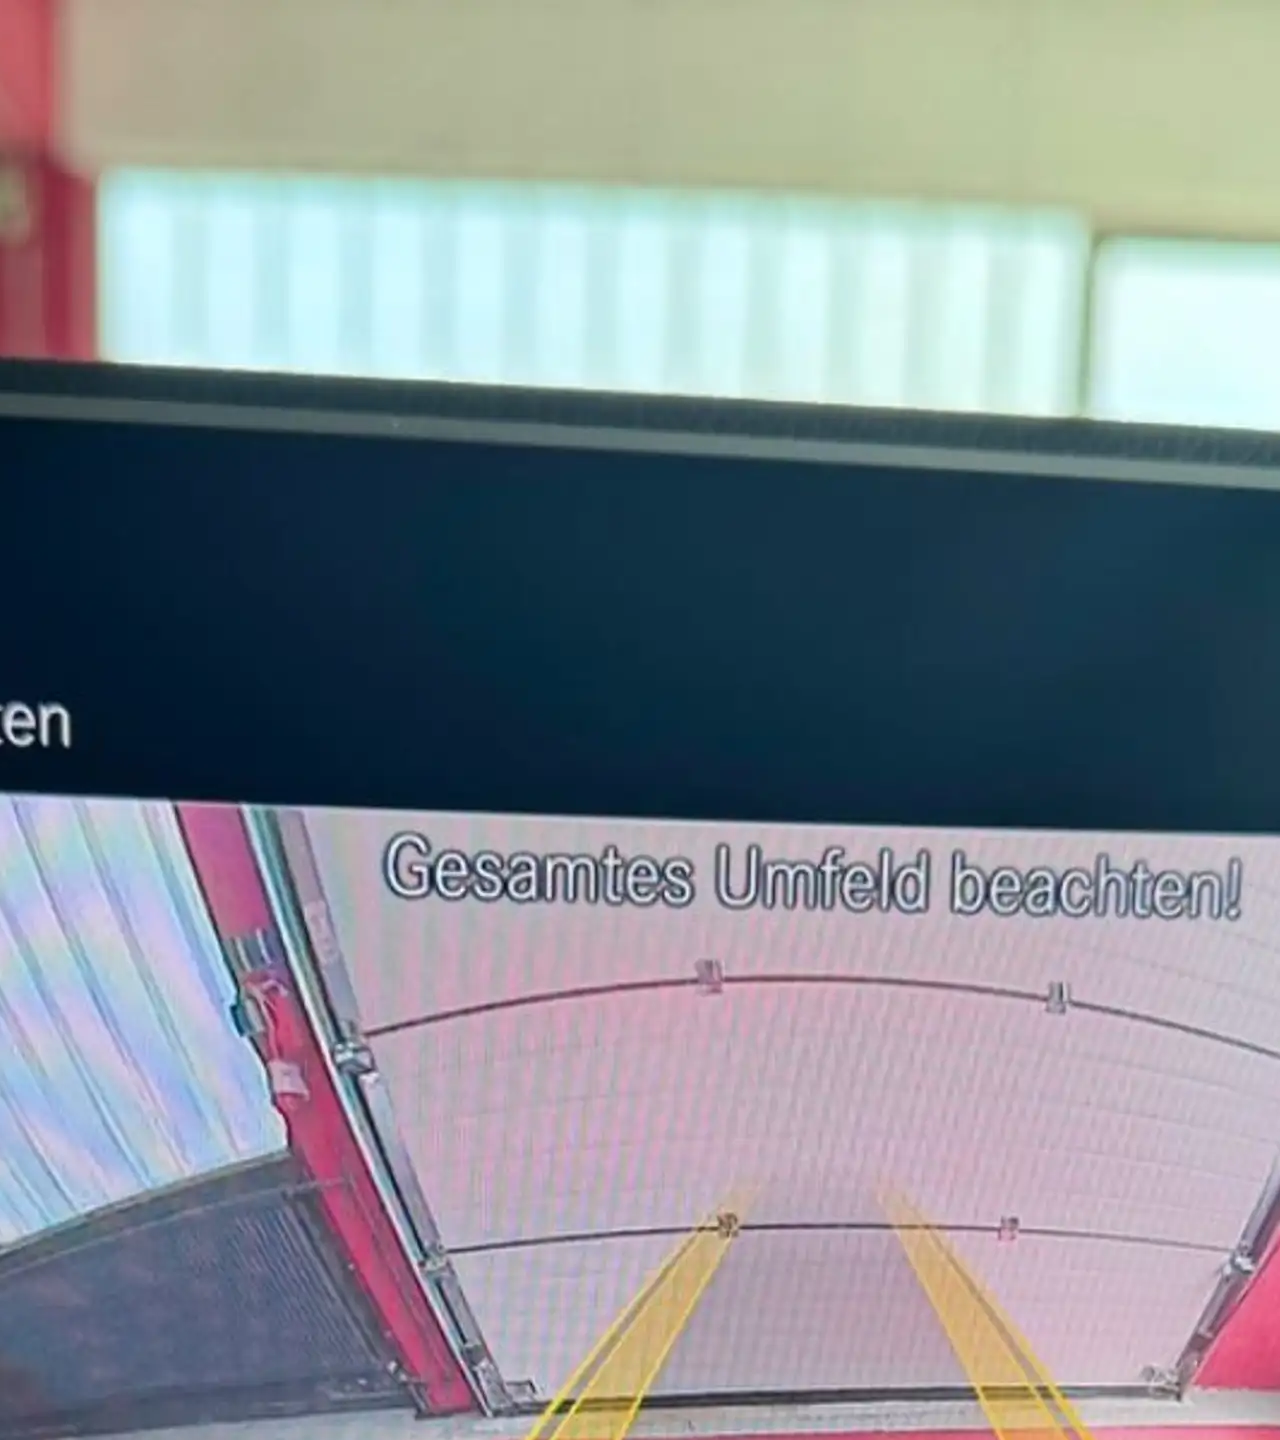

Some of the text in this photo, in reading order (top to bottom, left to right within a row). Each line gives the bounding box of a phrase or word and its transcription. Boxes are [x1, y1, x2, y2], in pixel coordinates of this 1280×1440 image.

[384, 831, 1243, 922] Gesamtes Umfeld beachten!
